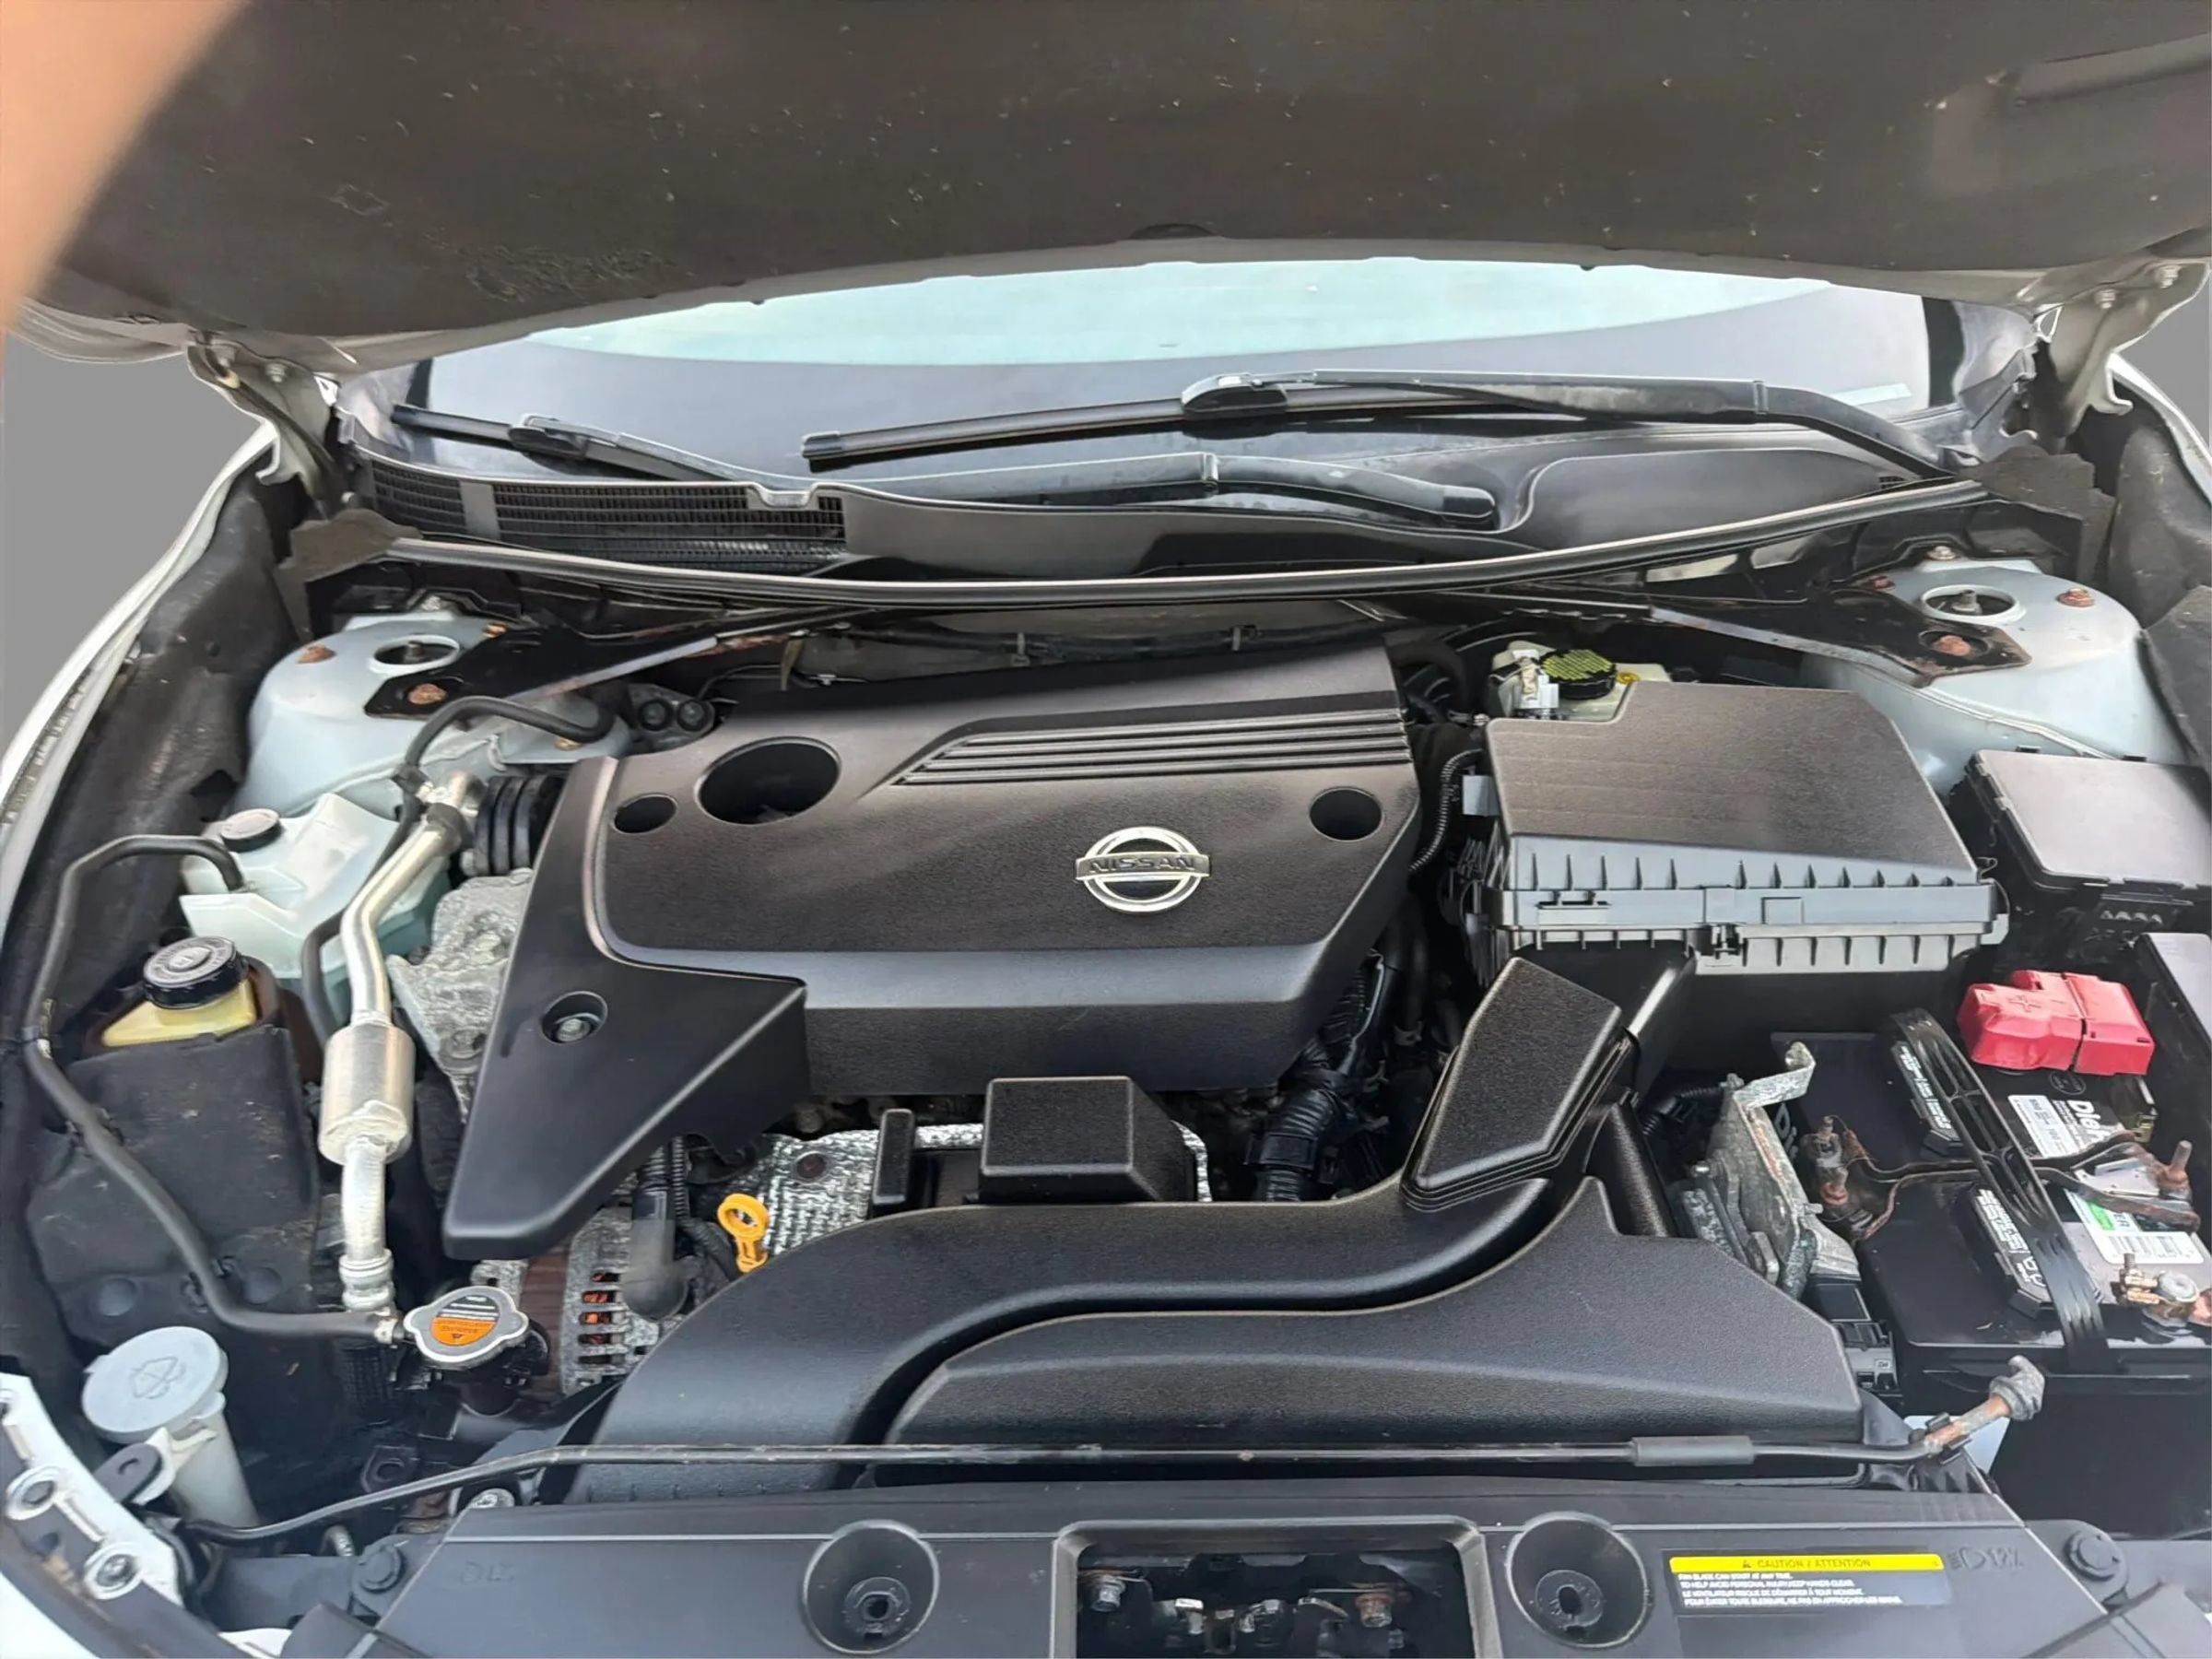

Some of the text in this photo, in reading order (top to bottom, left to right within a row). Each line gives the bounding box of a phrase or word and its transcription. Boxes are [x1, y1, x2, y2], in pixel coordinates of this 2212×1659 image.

[1089, 855, 1195, 873] NISSAN
[1757, 1559, 1804, 1568] CAUTION
[1815, 1559, 1871, 1568] ATTENTION
